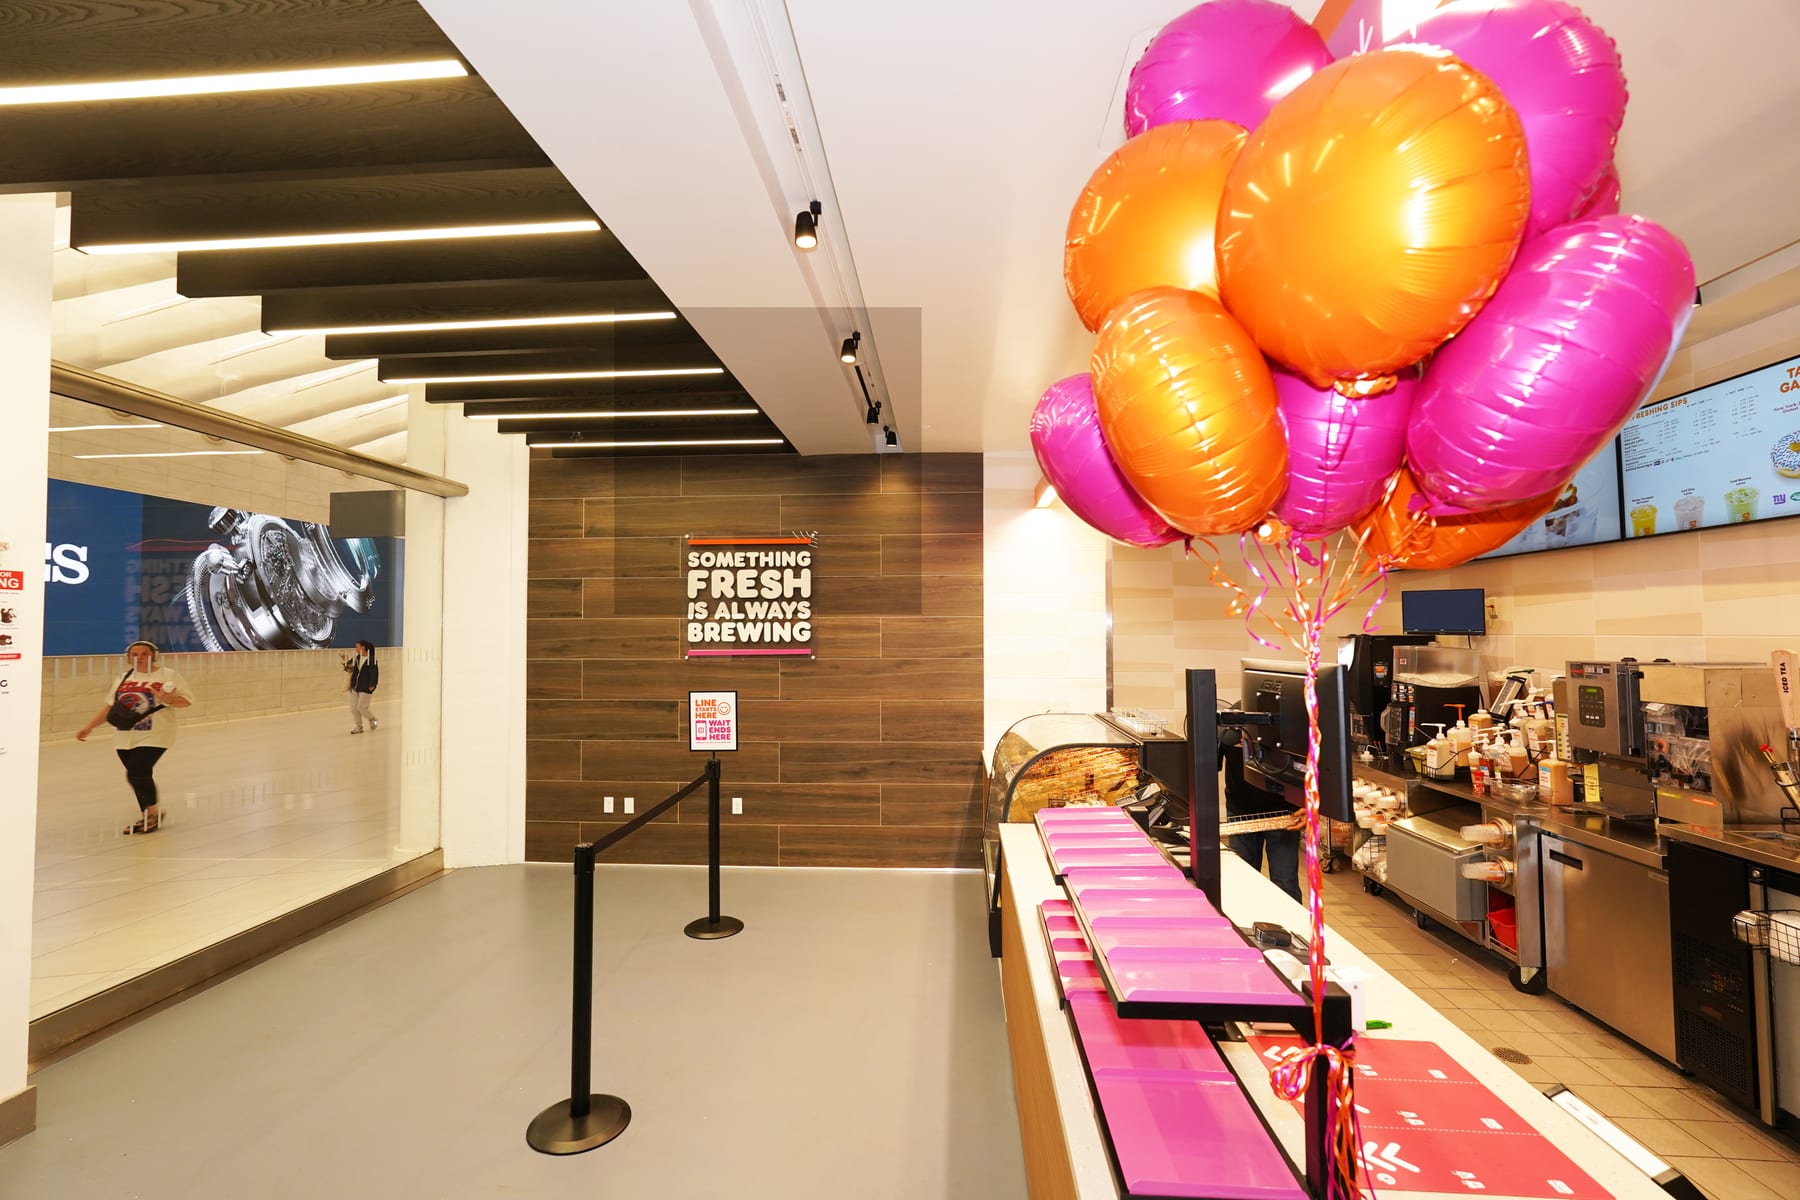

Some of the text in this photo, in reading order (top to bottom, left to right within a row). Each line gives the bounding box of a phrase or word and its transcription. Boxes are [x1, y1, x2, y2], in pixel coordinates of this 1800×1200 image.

[1670, 398, 1688, 409] SIPS
[688, 551, 811, 568] SOMETHING
[688, 568, 811, 599] FRESH
[688, 601, 811, 620] IS ALWAYS
[688, 621, 811, 643] BREWING
